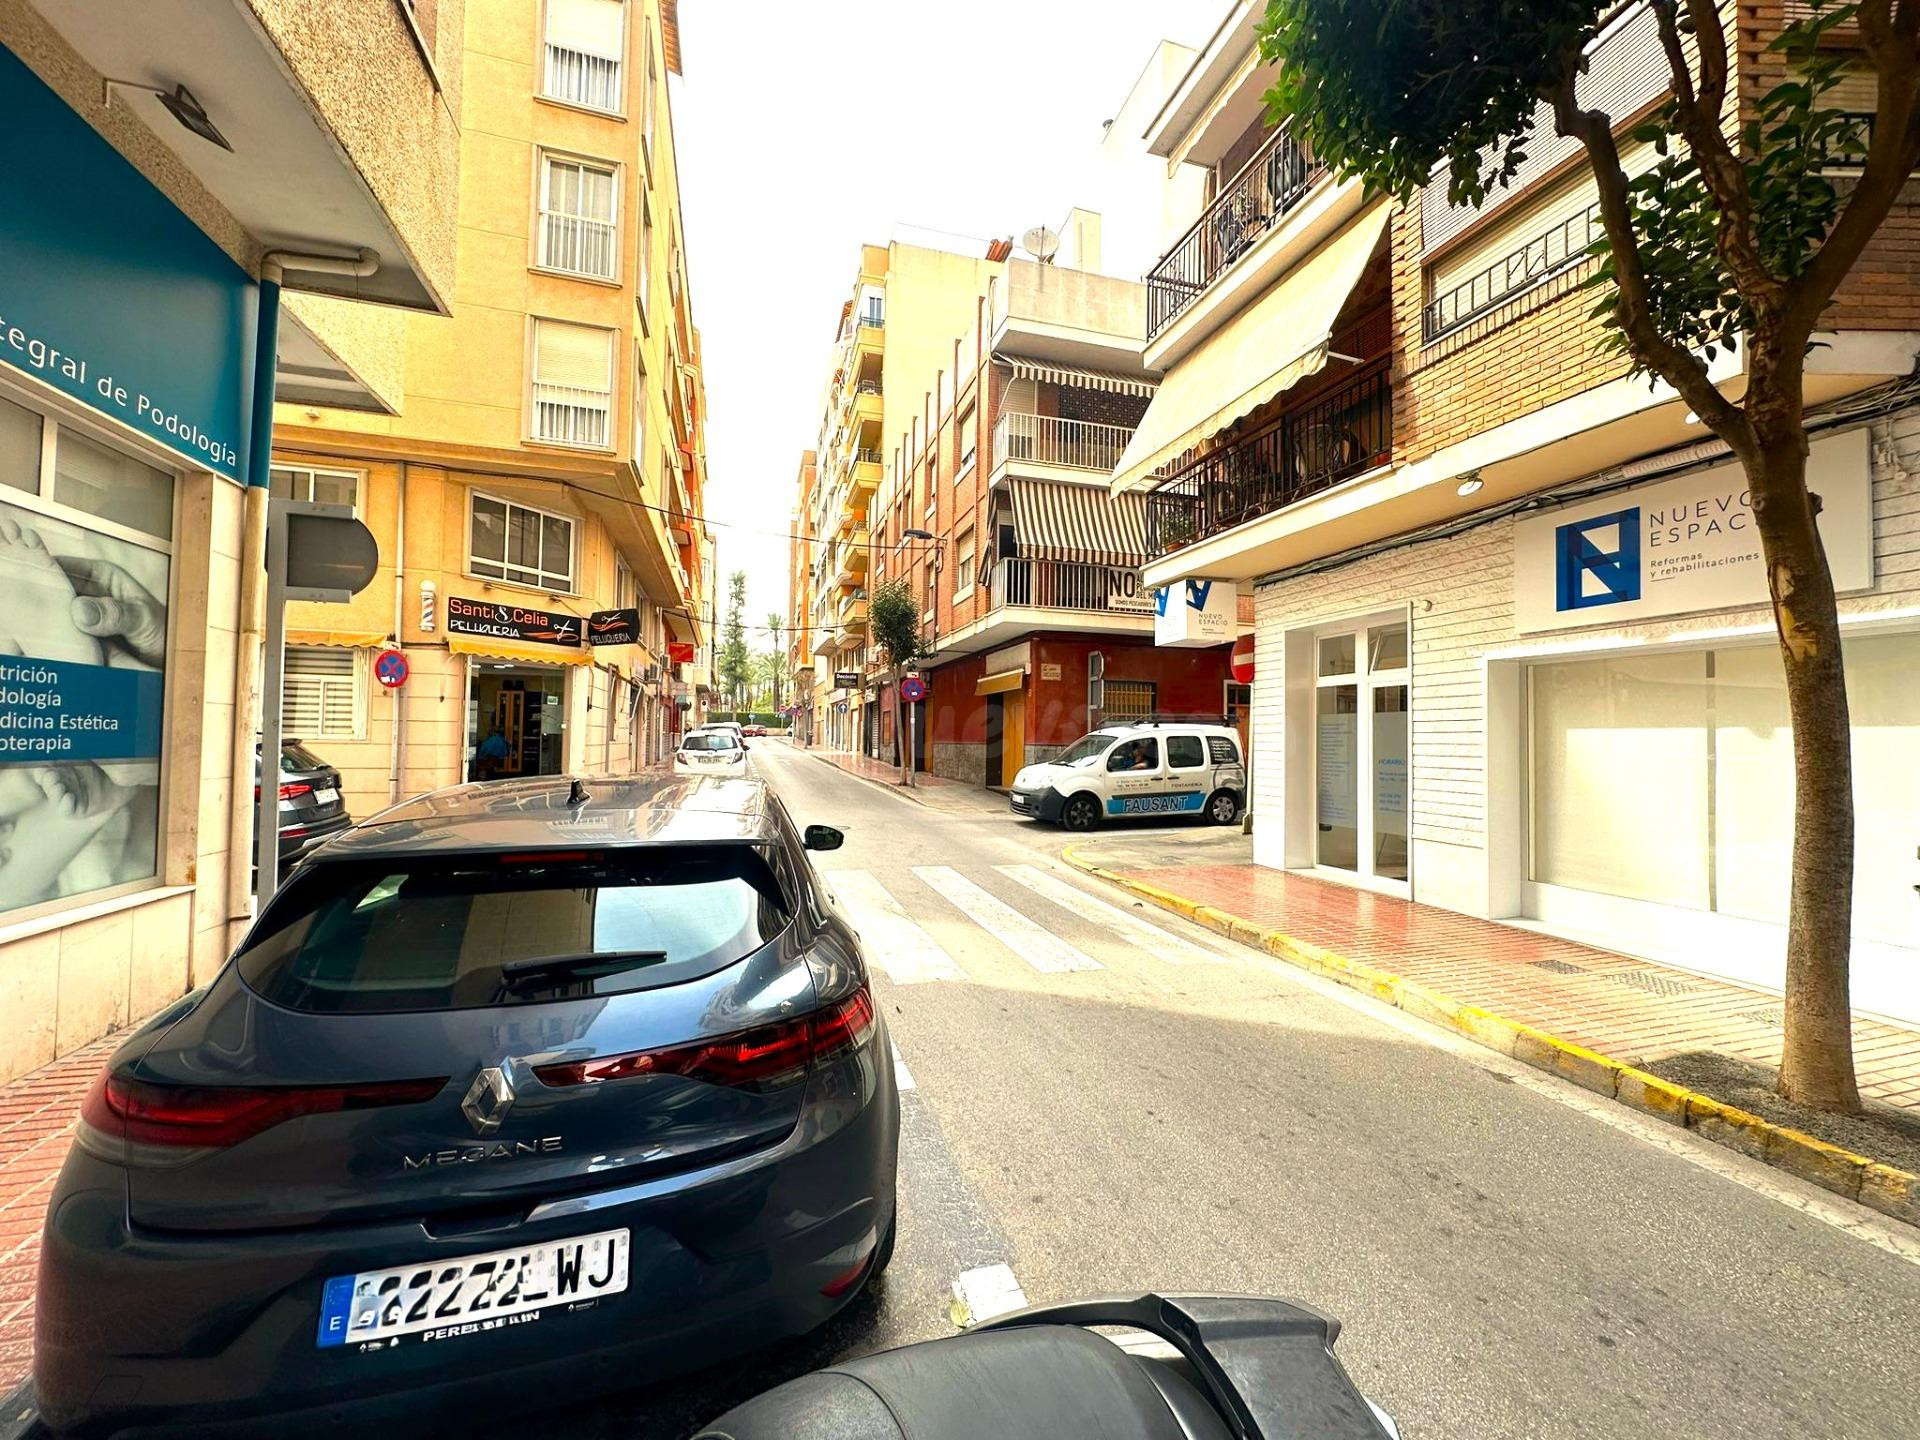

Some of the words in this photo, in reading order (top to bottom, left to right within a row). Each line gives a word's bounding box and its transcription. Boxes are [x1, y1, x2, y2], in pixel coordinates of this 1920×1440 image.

[97, 376, 128, 407] de
[1650, 551, 1704, 568] Reformas
[1660, 552, 1761, 576] rehabilitaciones
[1109, 570, 1136, 598] NO
[450, 599, 495, 619] Santi
[512, 608, 549, 626] Celia
[450, 619, 520, 638] PELUQUERIA
[591, 632, 632, 645] PELUQUERIA
[60, 713, 119, 730] Estética
[1123, 796, 1188, 813] FAUSANT
[404, 1135, 563, 1170] MEGANE
[329, 1316, 341, 1331] E
